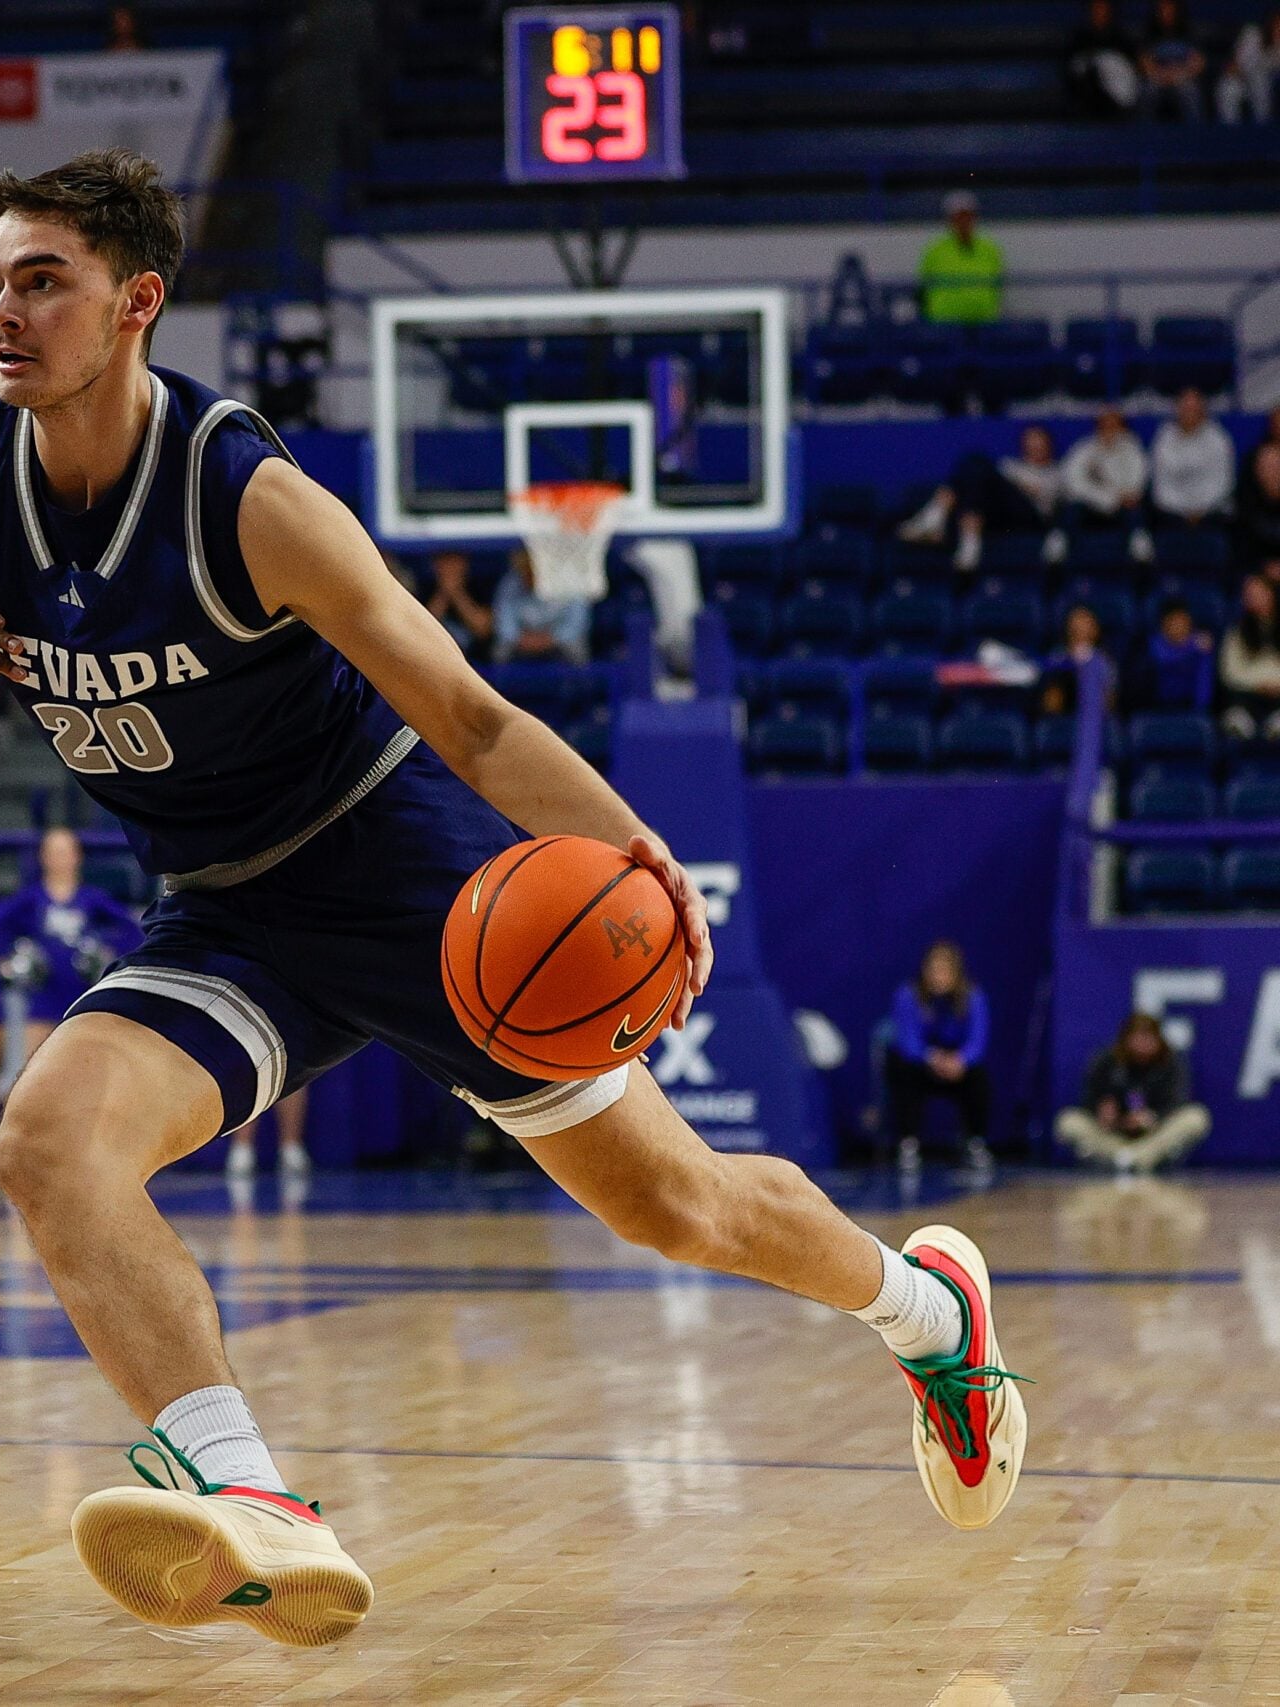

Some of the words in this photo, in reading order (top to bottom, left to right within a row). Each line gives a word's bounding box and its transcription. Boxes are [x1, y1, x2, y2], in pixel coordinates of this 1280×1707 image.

[552, 25, 661, 76] 6:11
[542, 71, 646, 163] 23
[31, 701, 175, 774] 20
[601, 909, 654, 960] AF
